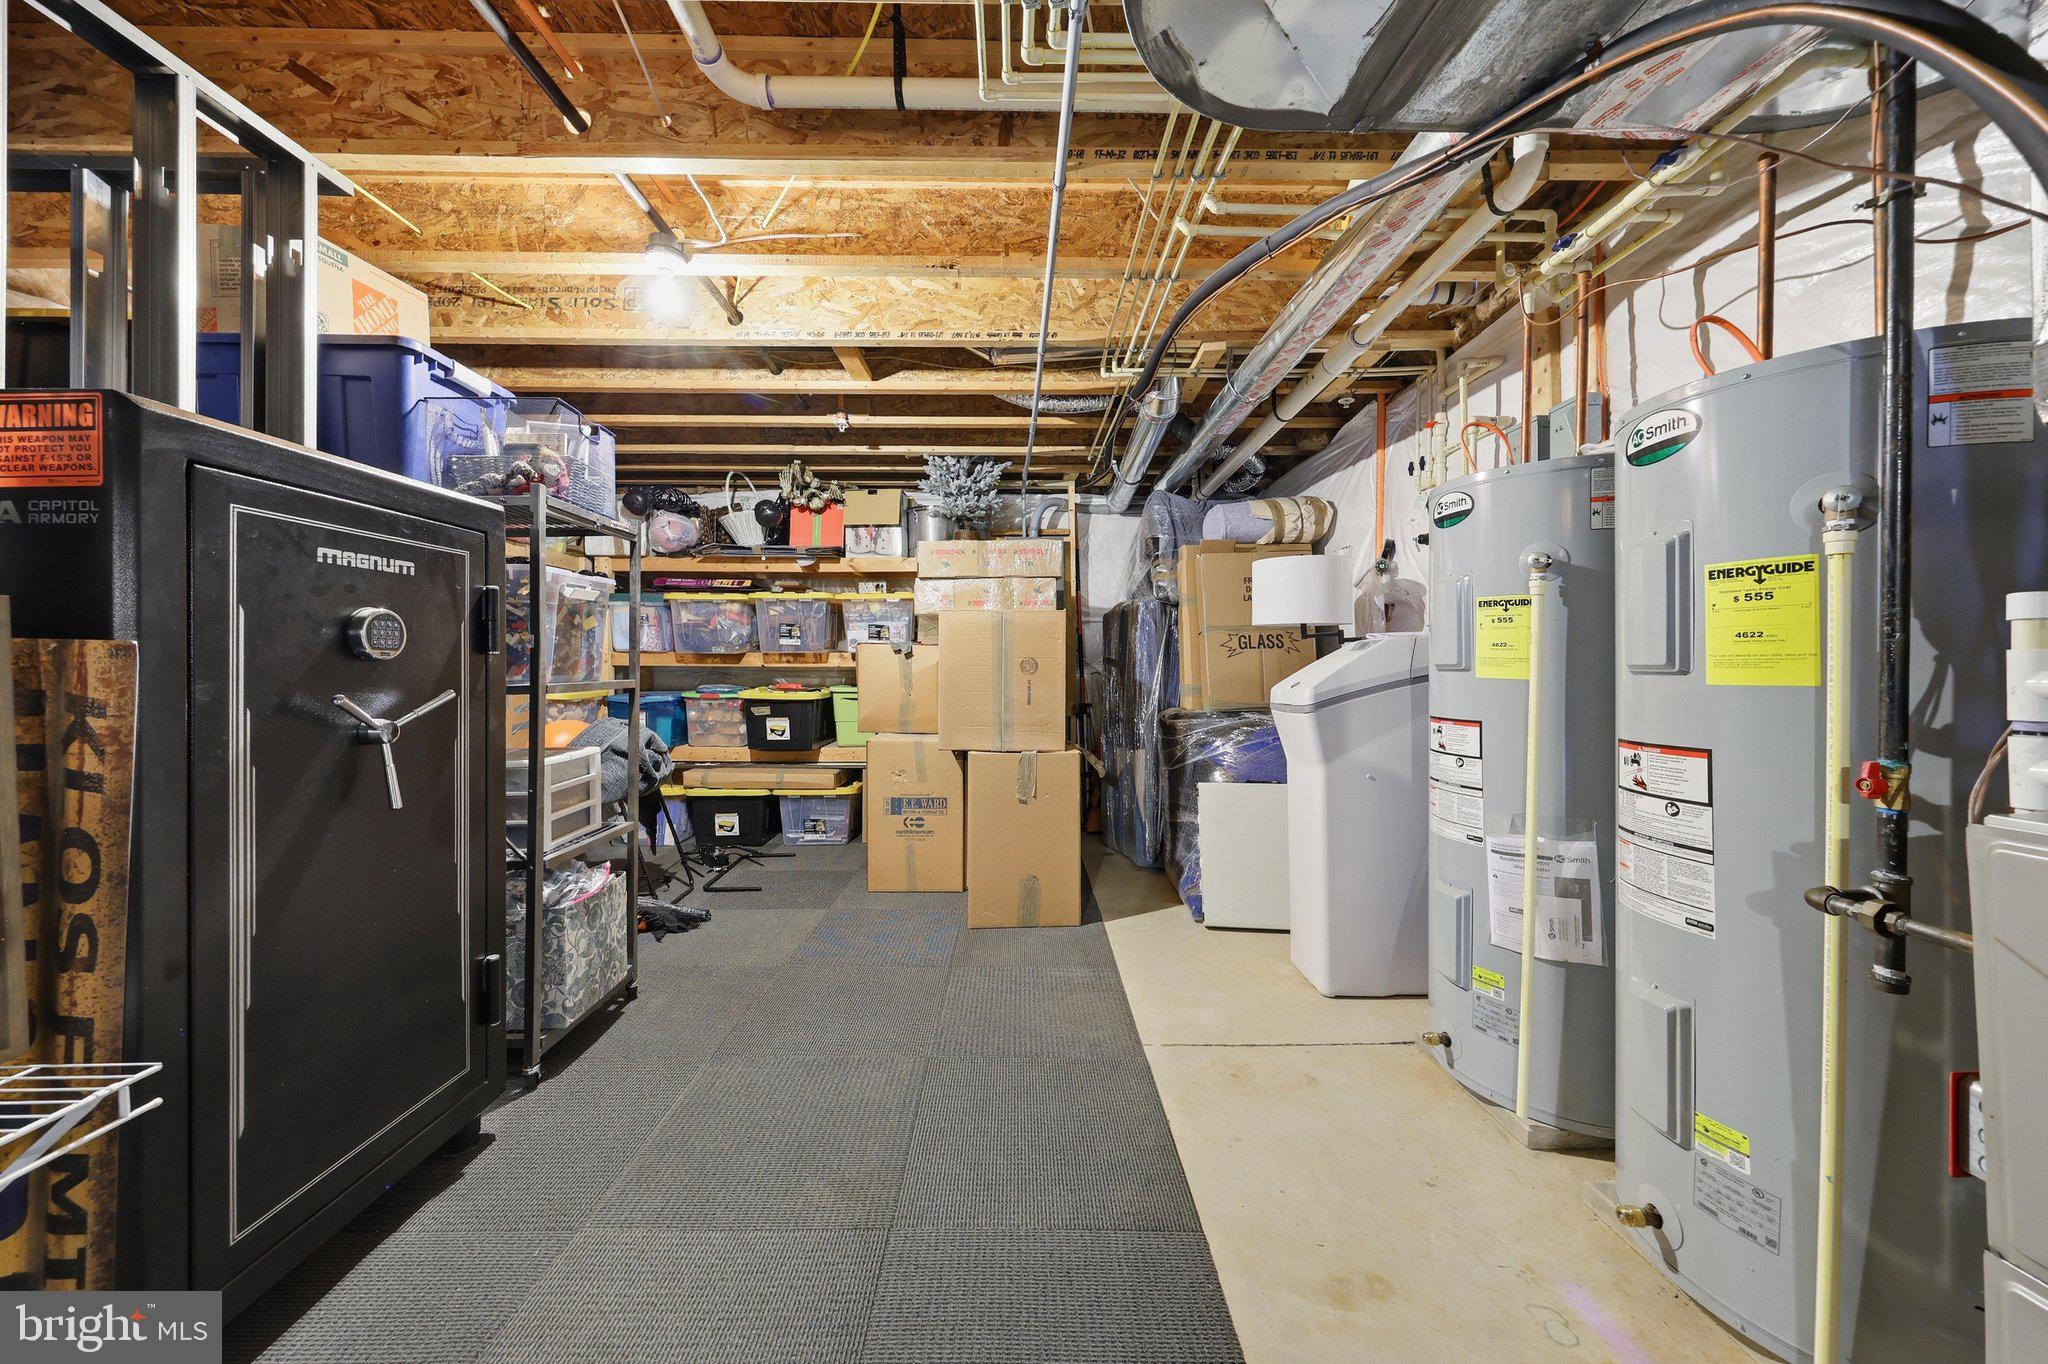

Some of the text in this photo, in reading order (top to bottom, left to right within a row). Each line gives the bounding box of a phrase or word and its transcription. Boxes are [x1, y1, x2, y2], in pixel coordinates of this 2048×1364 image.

[1645, 416, 1687, 440] Smith
[18, 434, 65, 444] WEAPON
[68, 434, 91, 443] MAY
[14, 444, 65, 453] PROTECT
[69, 444, 91, 452] YOU
[77, 453, 91, 461] OR
[39, 463, 96, 472] WEAPONS.
[28, 500, 100, 511] CAPITOL
[27, 513, 101, 524] ARMORY
[316, 546, 415, 576] MAGNUM
[1707, 560, 1816, 584] ENERGYGUIDE
[1744, 591, 1775, 602] 555
[1734, 631, 1764, 639] 4622
[1238, 633, 1284, 650] GLASS
